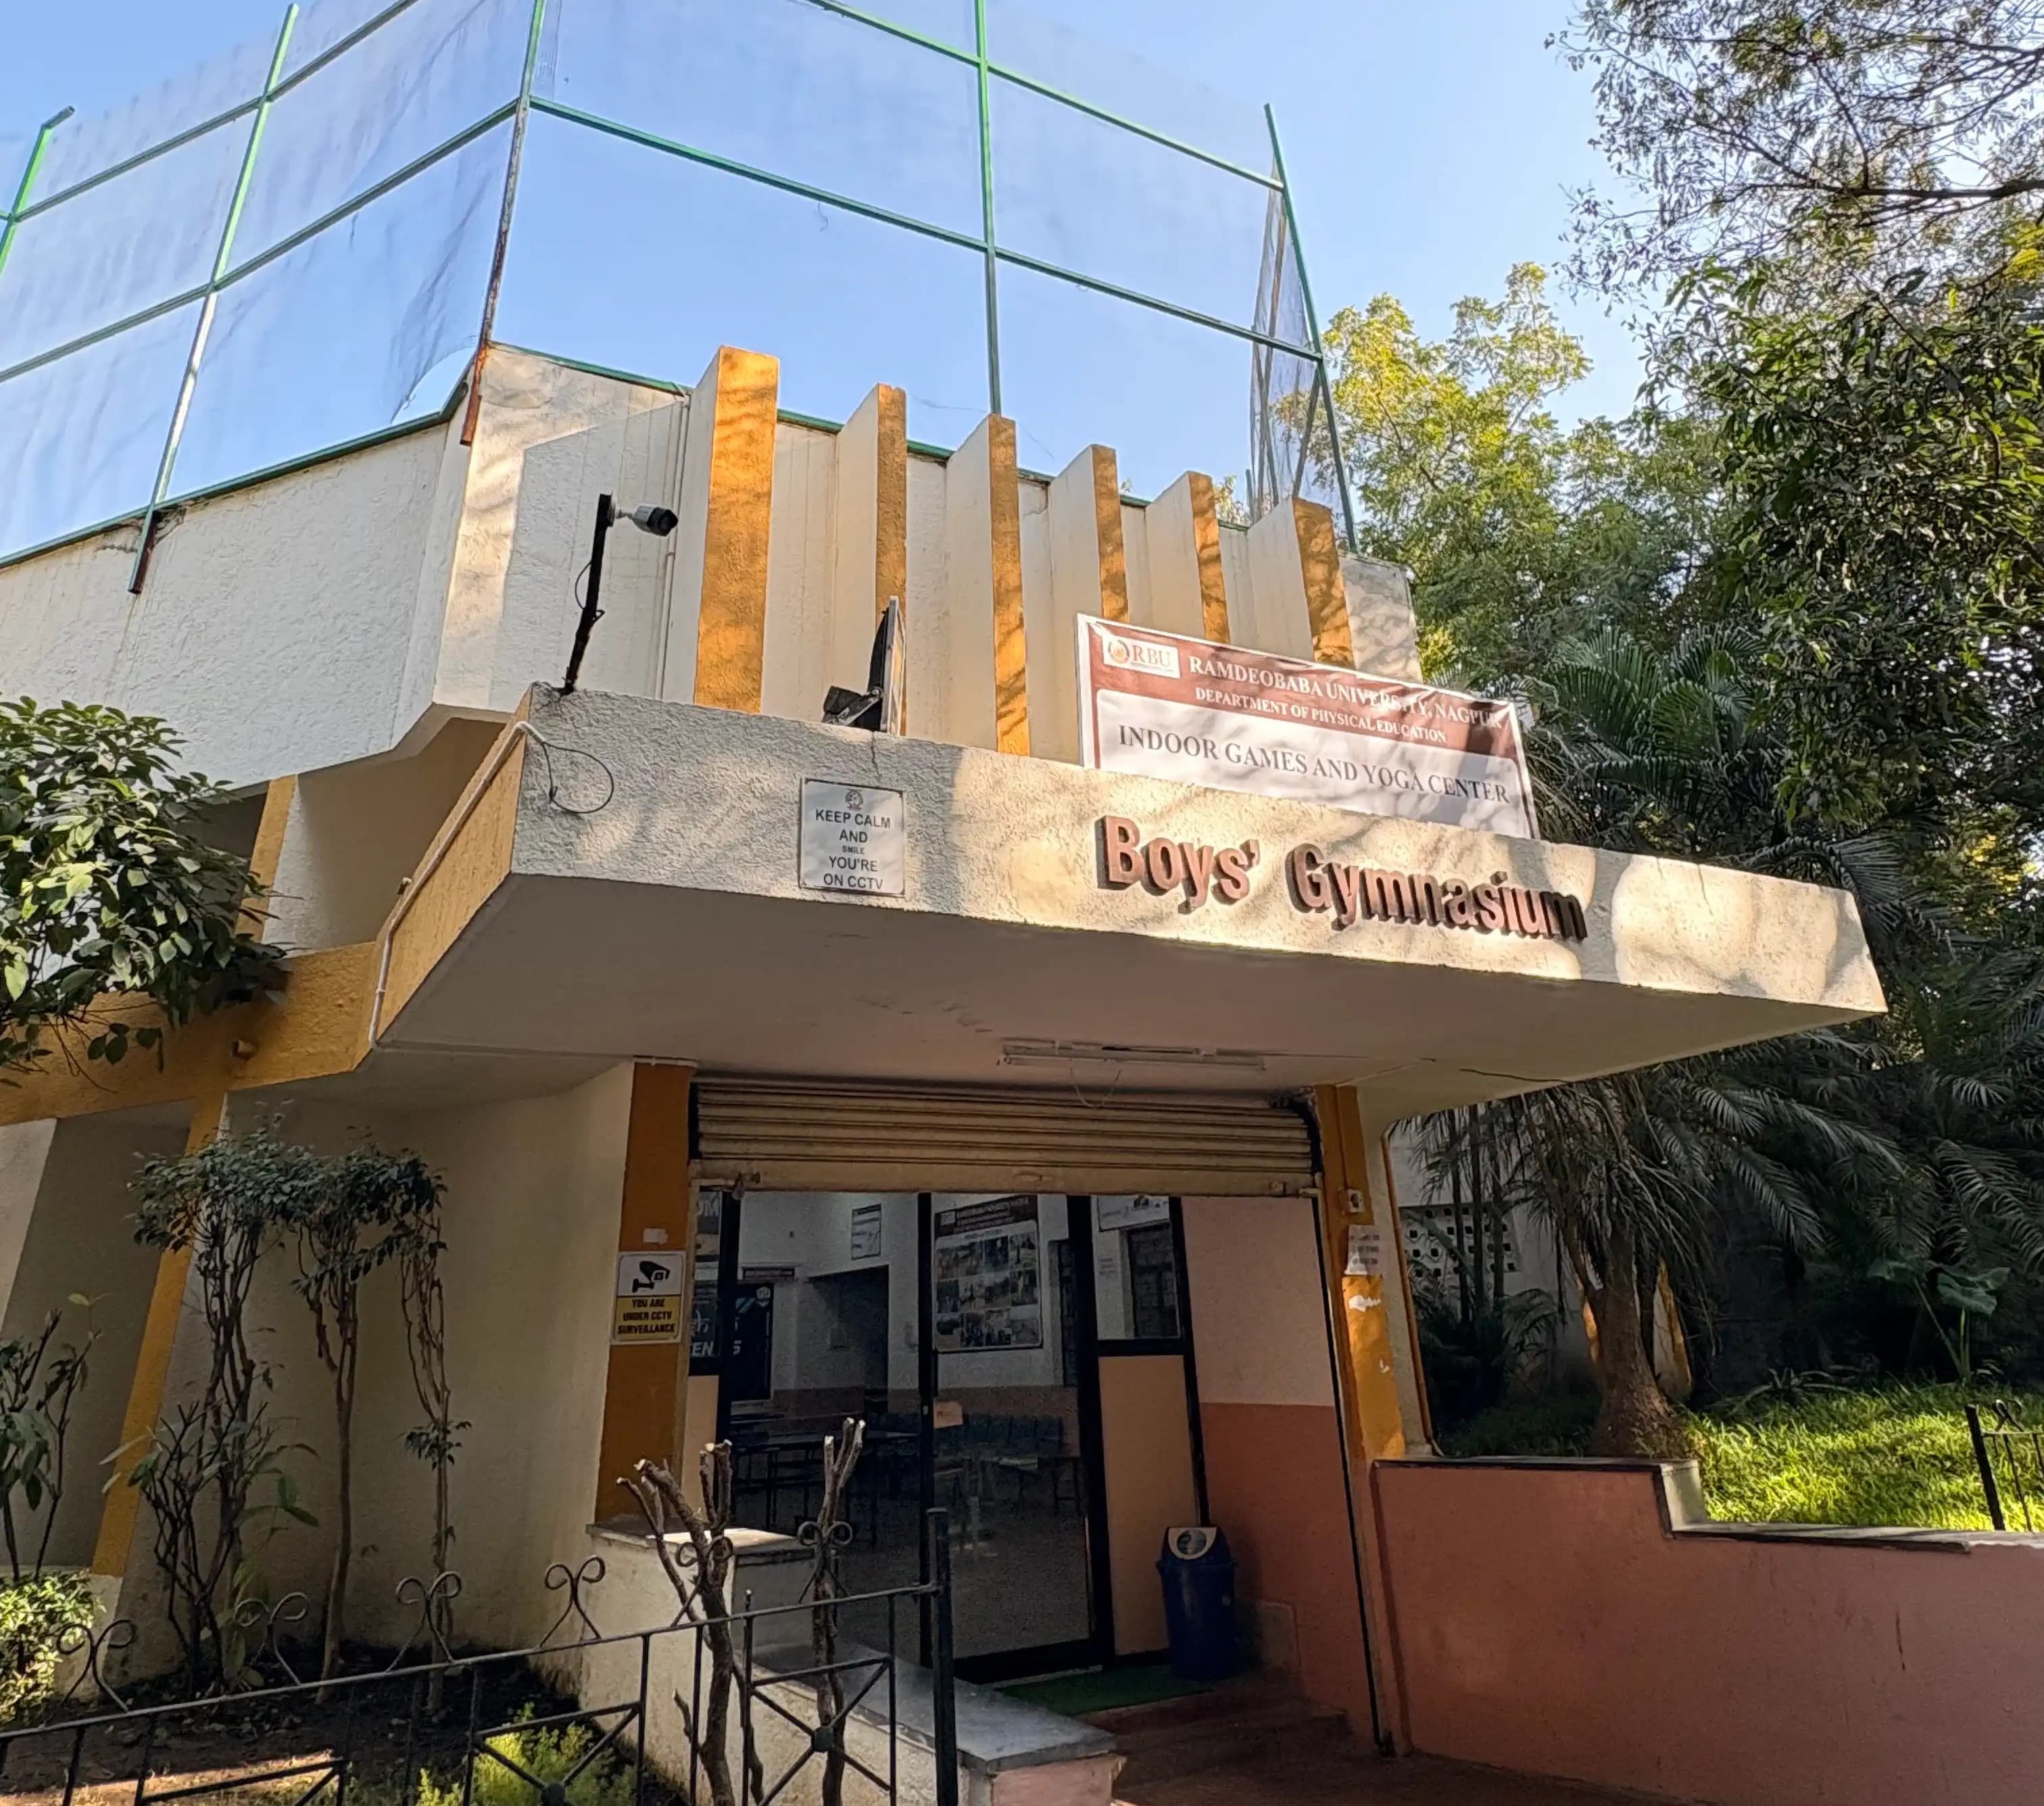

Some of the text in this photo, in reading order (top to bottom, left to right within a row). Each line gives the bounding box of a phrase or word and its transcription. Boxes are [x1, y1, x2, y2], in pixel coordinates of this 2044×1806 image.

[1131, 644, 1171, 666] RBU
[1188, 656, 1323, 697] RAMDEOBABA
[1195, 687, 1447, 743] DEPARTMENT OF PHYSICAL EDUCATION
[1119, 725, 1511, 804] INDOOR GAMES AND YOGA CENTER
[815, 809, 890, 828] KEEP CALM
[839, 829, 868, 844] AND
[842, 846, 865, 855] SMILE
[829, 856, 878, 872] YOU'RE
[823, 873, 883, 890] ON CCTV
[1288, 842, 1587, 942] Gymnasium
[631, 1298, 666, 1308] YOU ARE
[623, 1311, 673, 1321] UNDER CCTV
[617, 1323, 675, 1335] SURVEILLANCE
